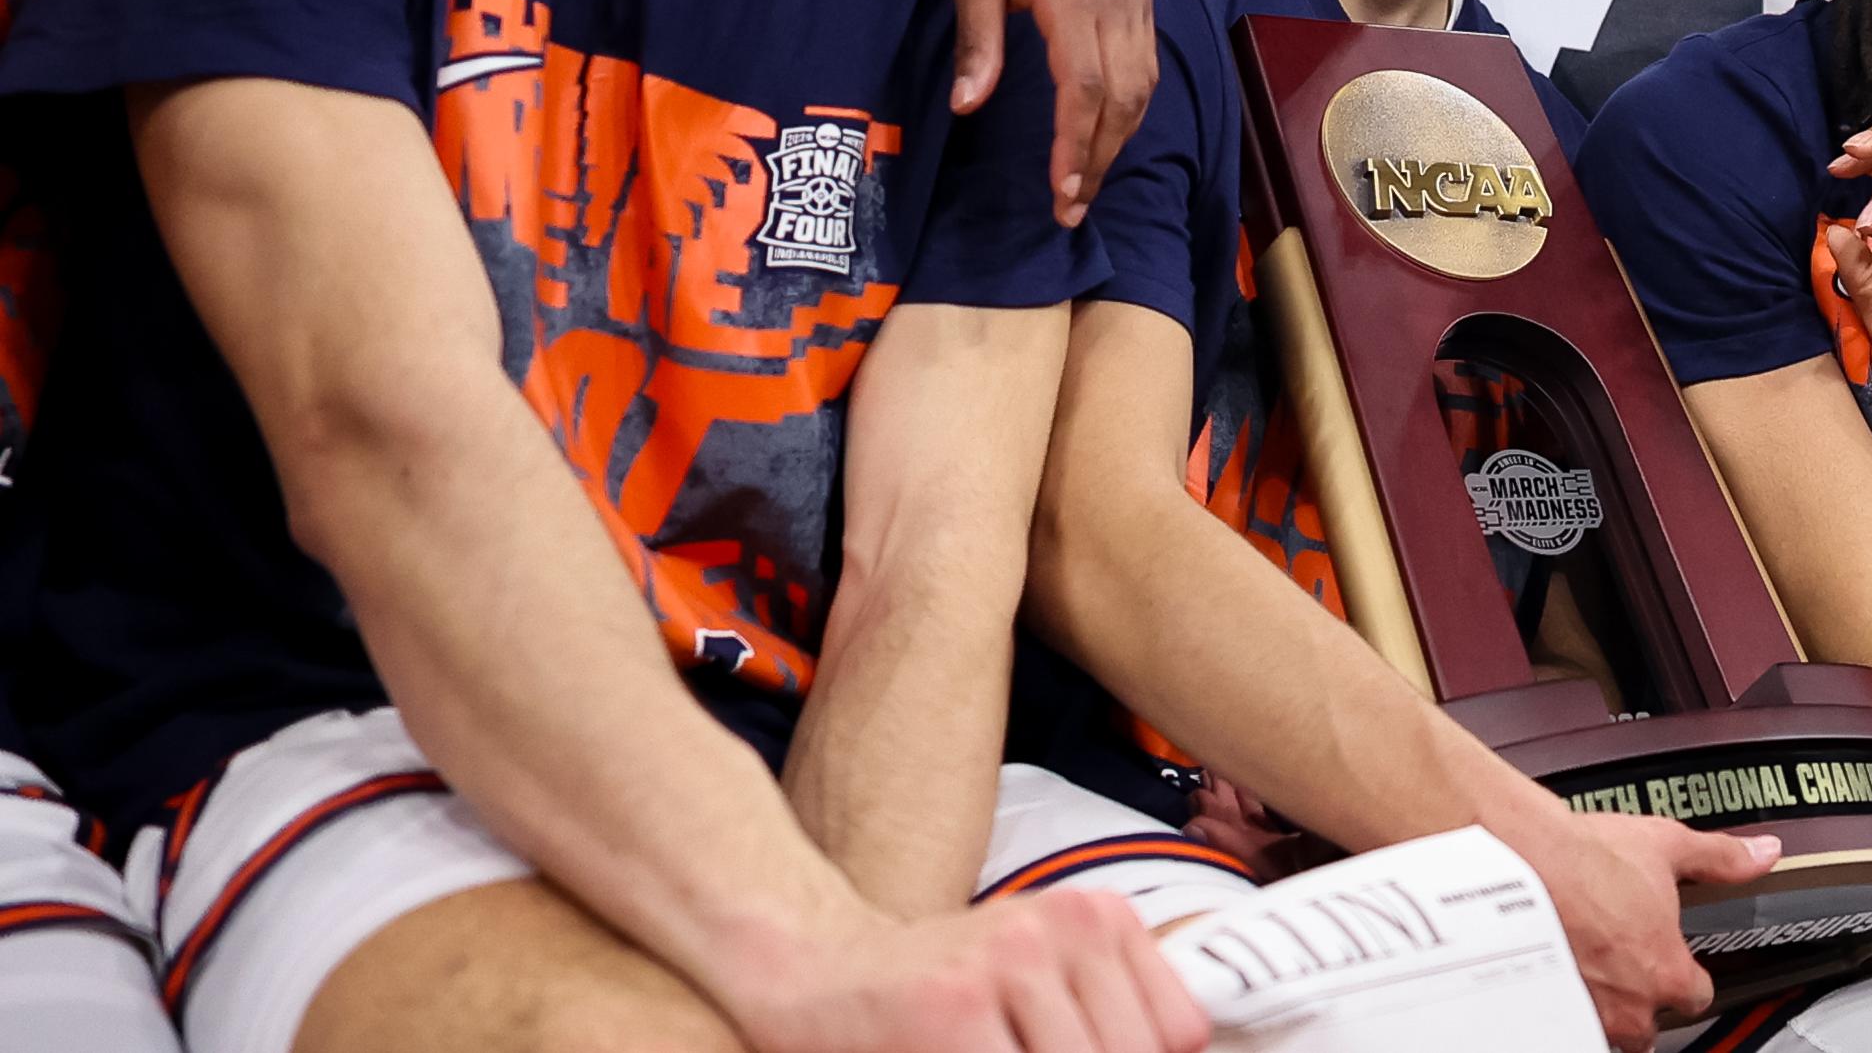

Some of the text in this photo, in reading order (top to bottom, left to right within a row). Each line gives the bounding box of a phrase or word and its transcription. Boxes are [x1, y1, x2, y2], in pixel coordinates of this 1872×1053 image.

[780, 149, 858, 187] FINAL
[1363, 157, 1554, 225] NCAA
[774, 211, 847, 246] FOUR
[1498, 455, 1523, 468] SWEET
[1488, 477, 1560, 499] MARCH
[1504, 498, 1601, 522] MADNESS
[1562, 783, 1642, 815] UTH
[1646, 764, 1798, 821] REGIONAL
